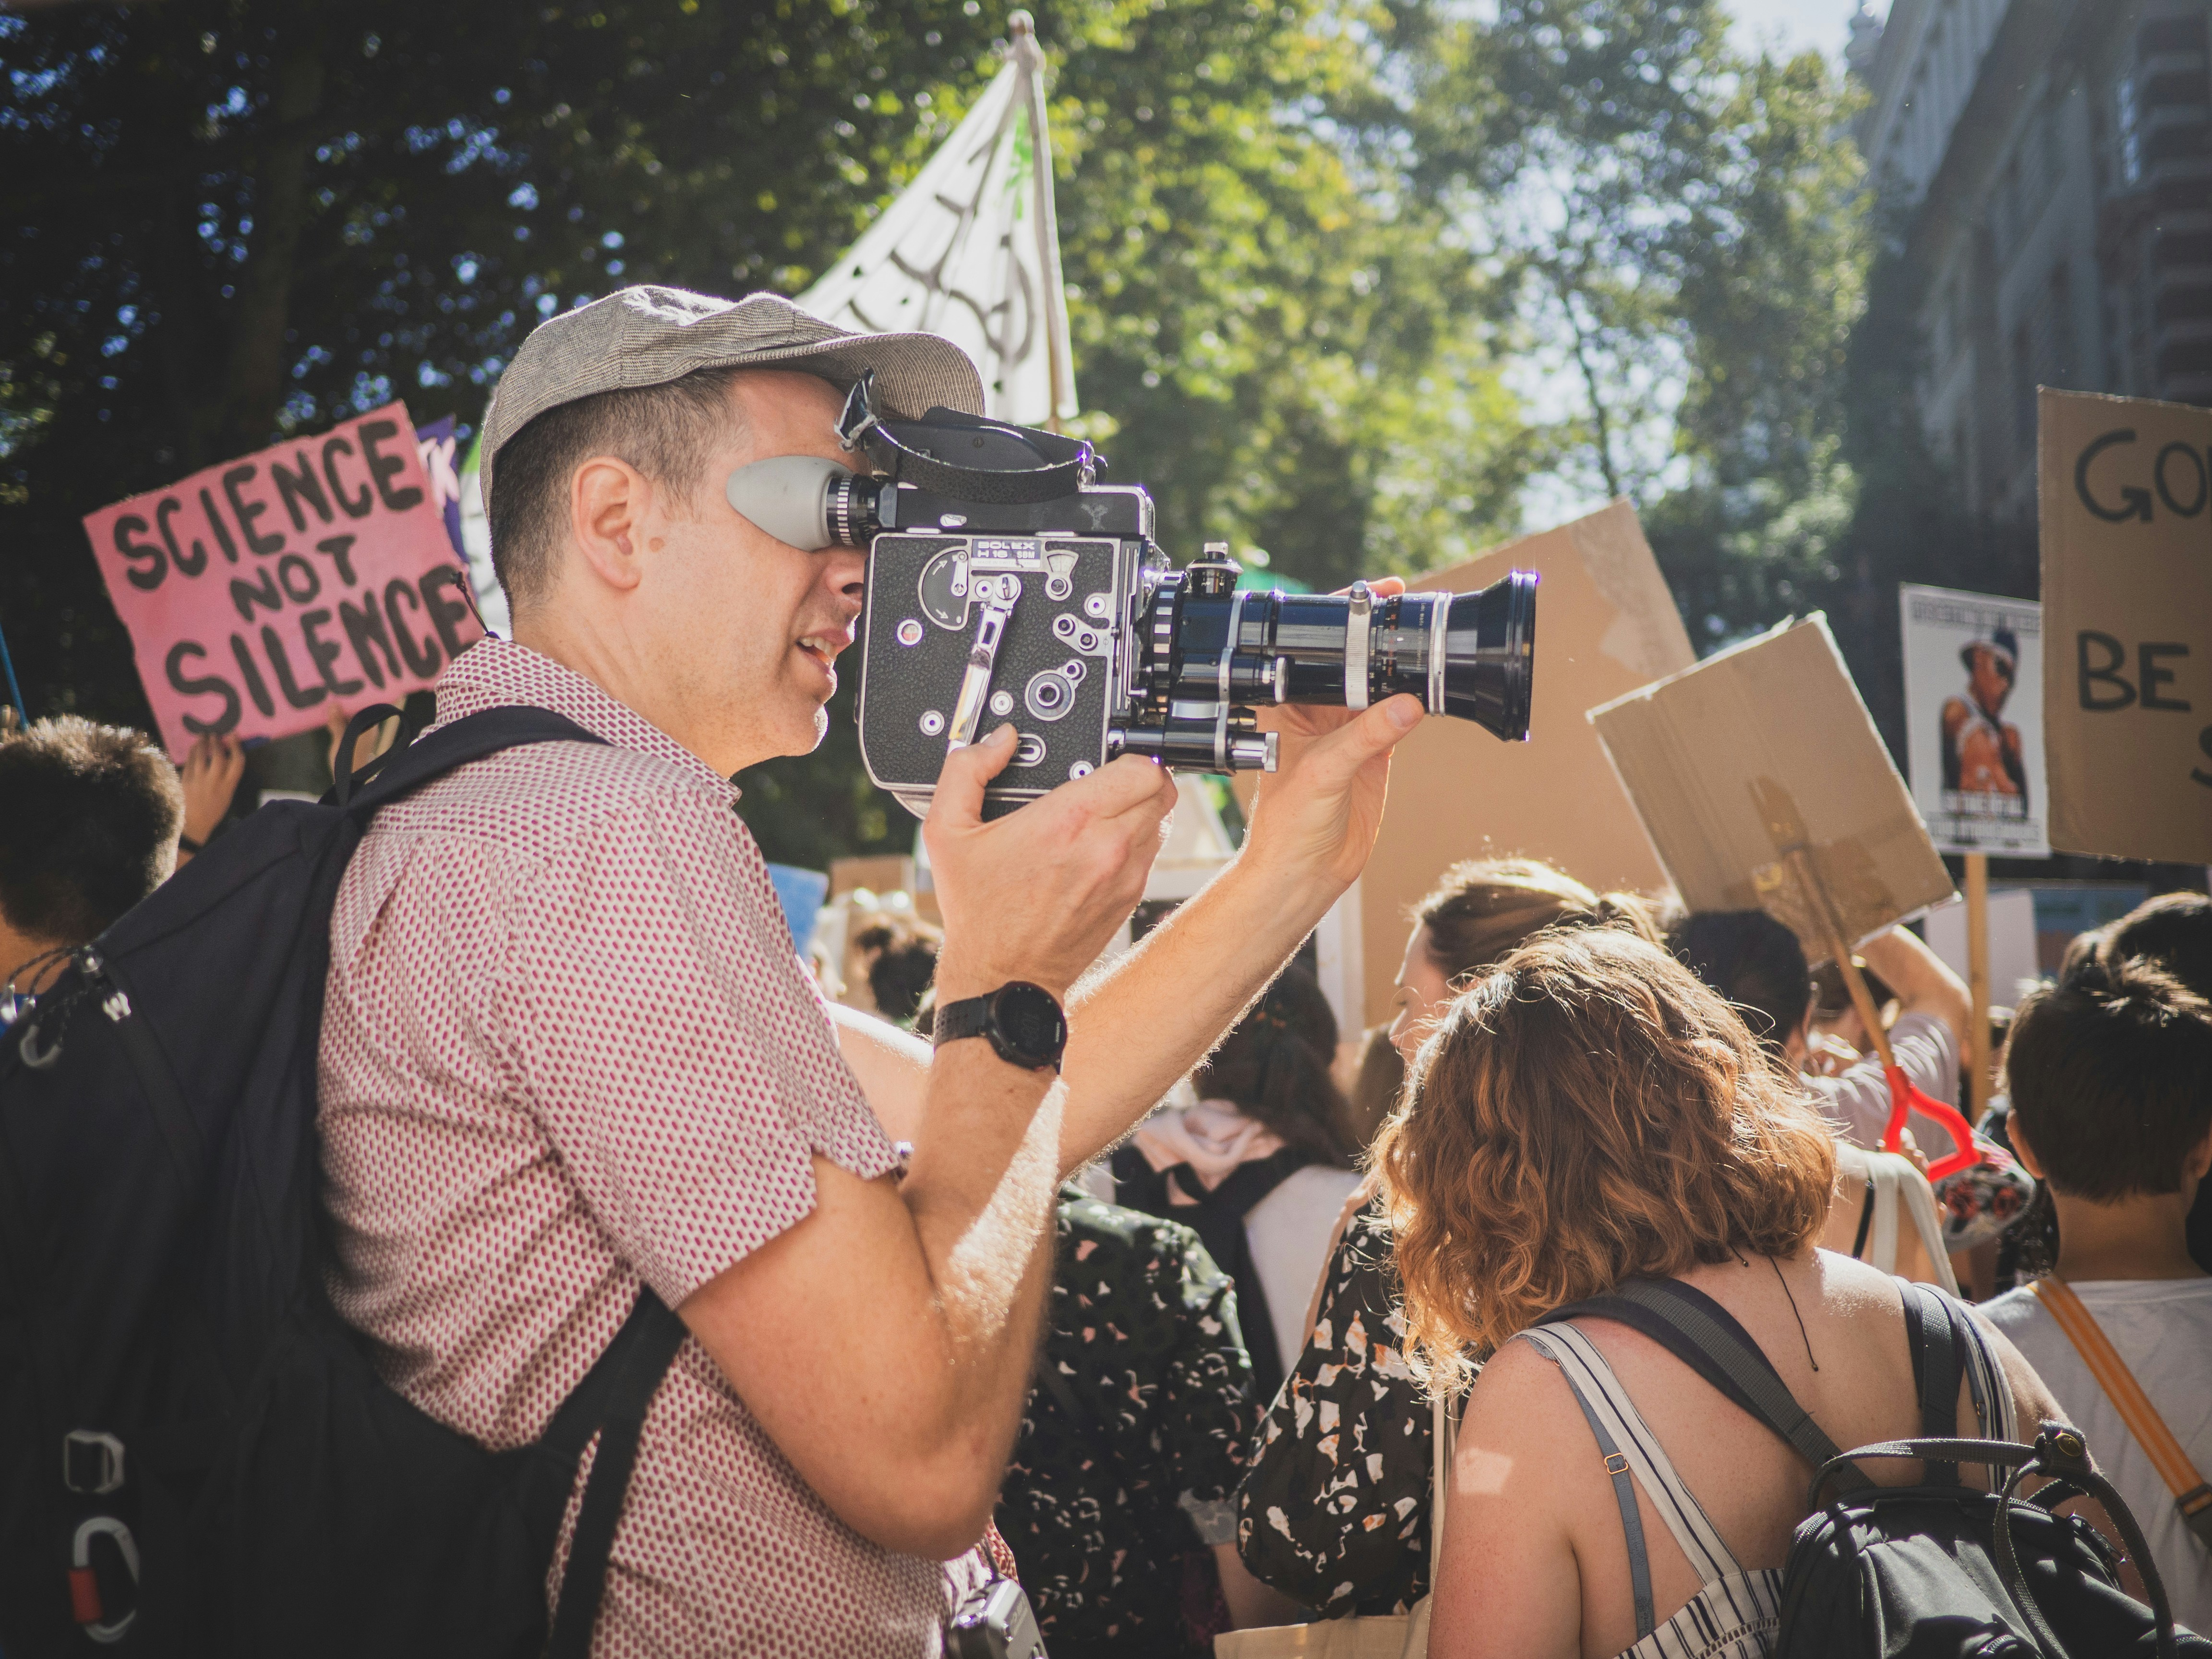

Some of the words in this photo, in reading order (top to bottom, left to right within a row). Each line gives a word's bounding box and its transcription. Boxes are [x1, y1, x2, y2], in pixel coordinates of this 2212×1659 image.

[113, 419, 423, 590] SCIENCE
[2074, 427, 2212, 523] GO
[229, 534, 357, 624] NOT
[977, 541, 1035, 550] BOLEX
[977, 550, 989, 558] H
[992, 550, 1008, 558] 16
[1016, 551, 1035, 559] SBM
[164, 564, 475, 735] SILENCE
[2077, 629, 2192, 712] BE
